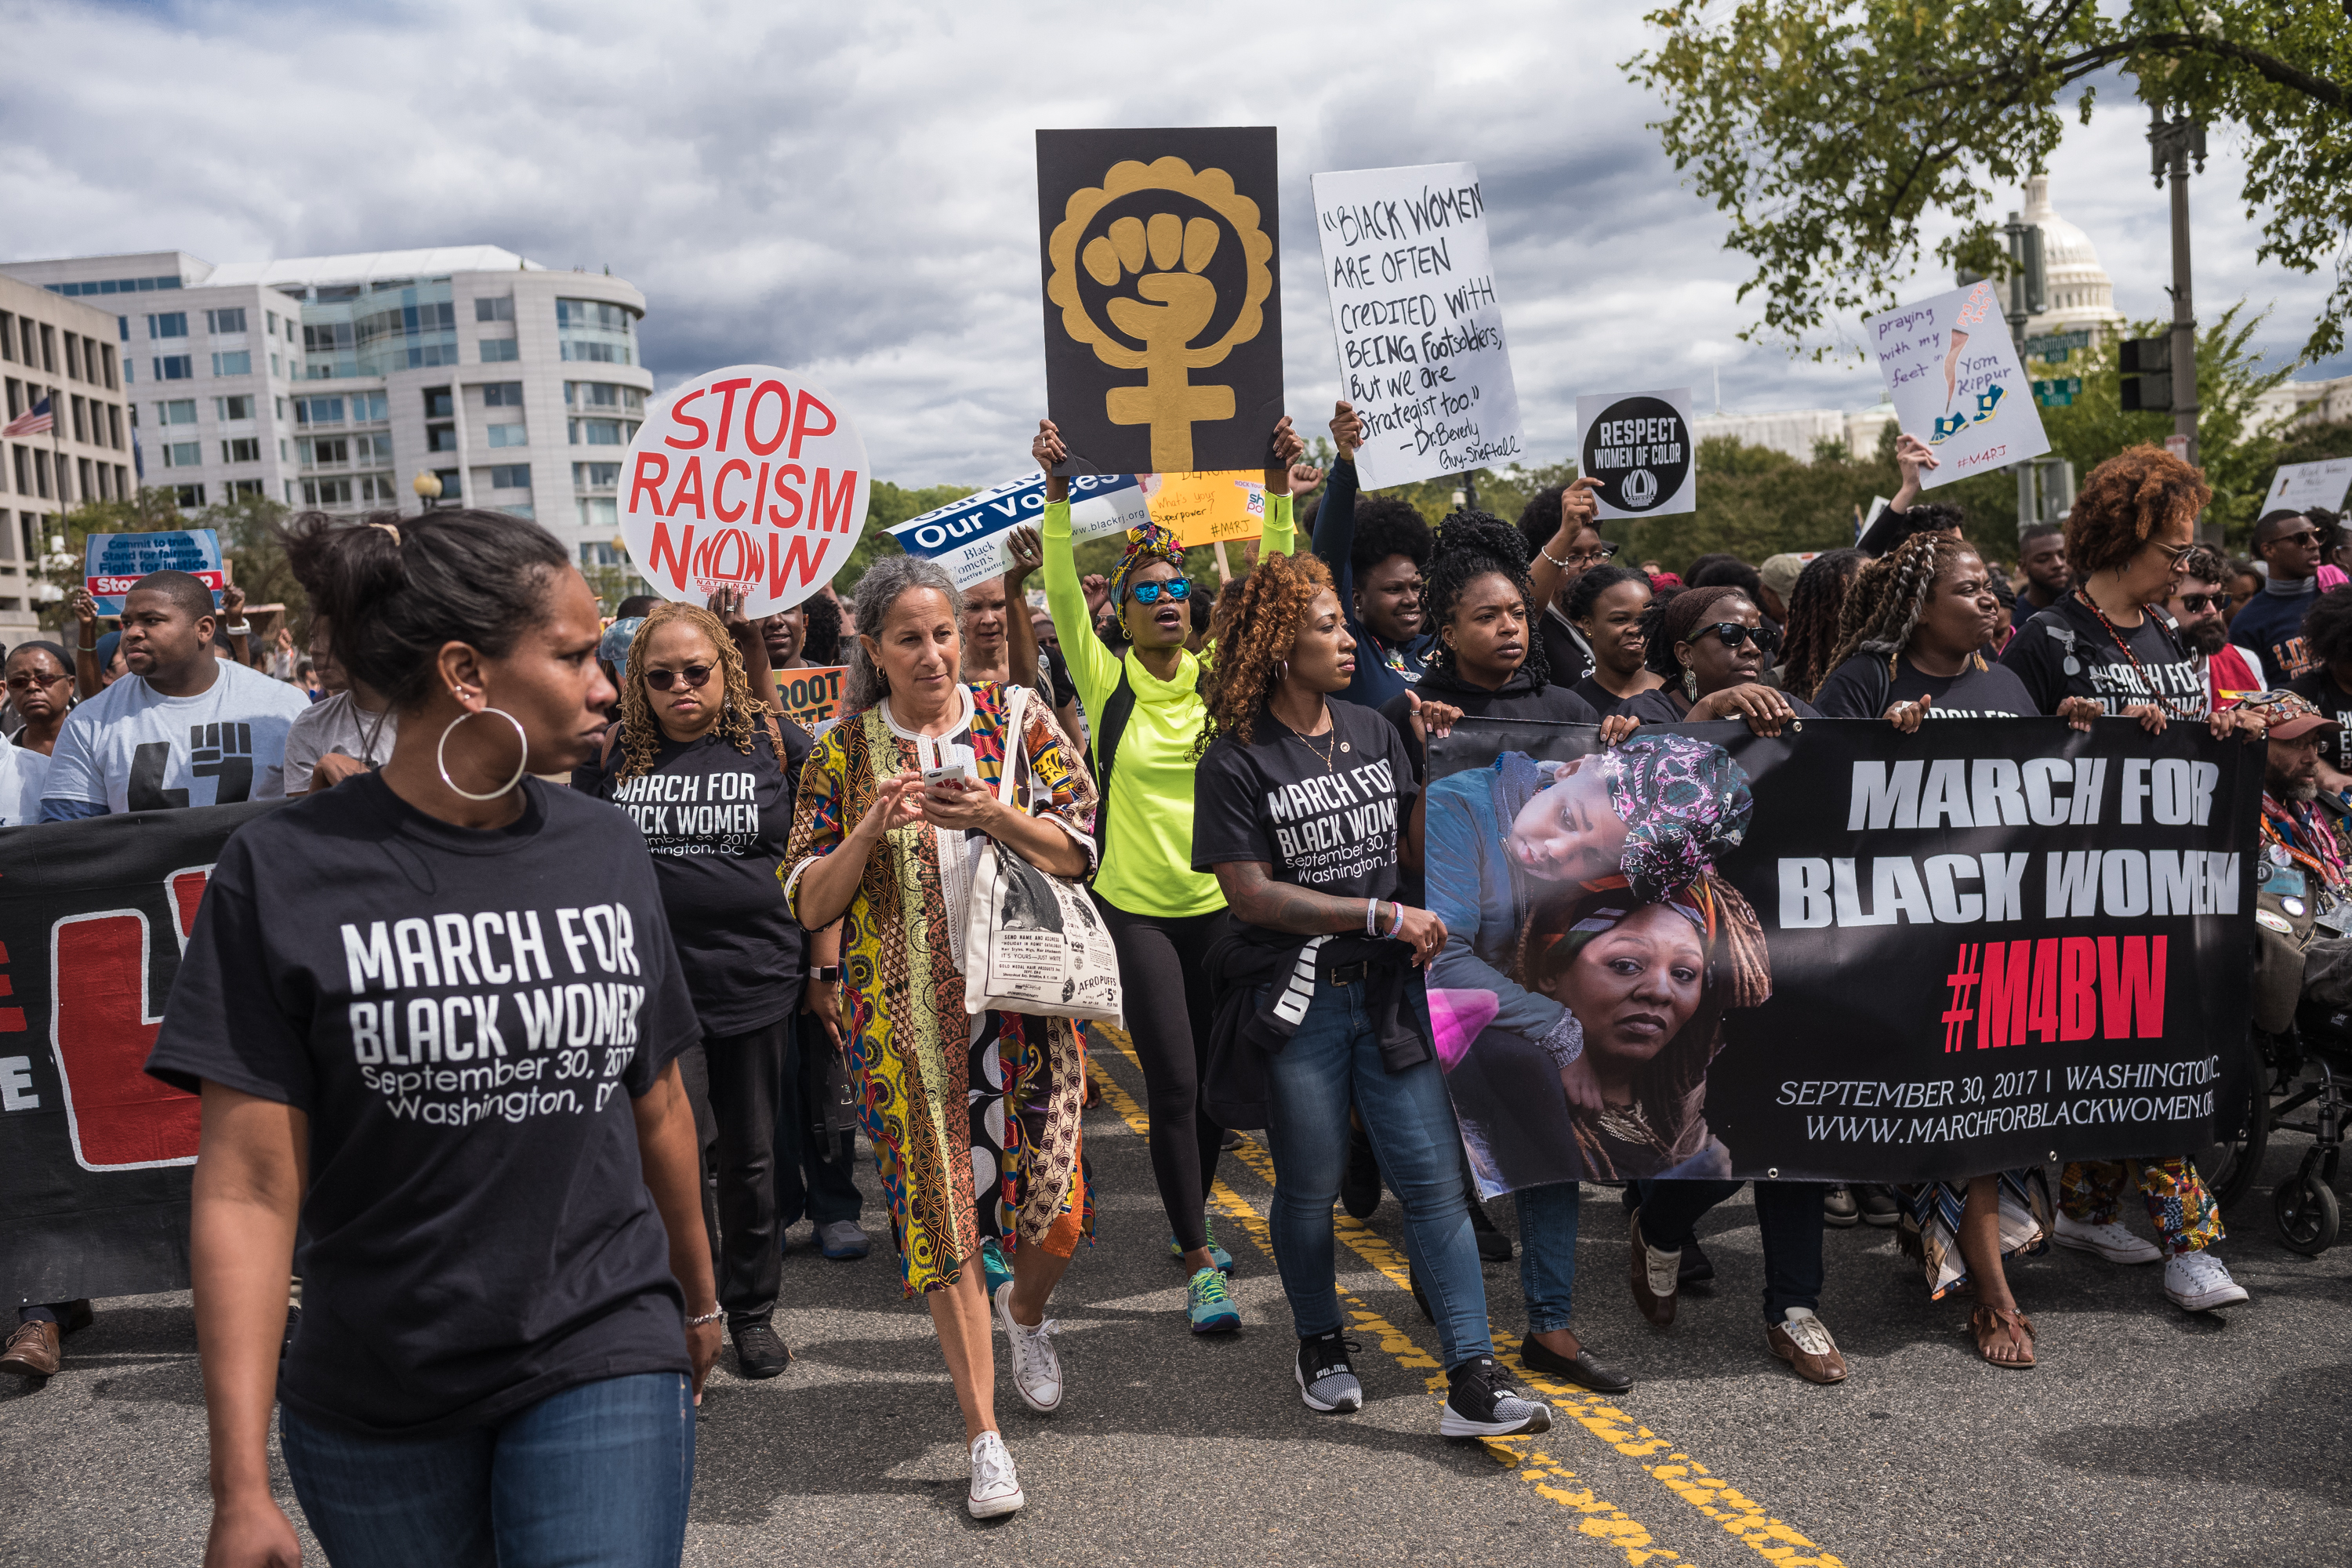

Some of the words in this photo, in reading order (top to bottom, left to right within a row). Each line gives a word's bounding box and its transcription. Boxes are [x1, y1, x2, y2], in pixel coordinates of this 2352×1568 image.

[1411, 182, 1485, 236] WOMEN
[1334, 255, 1375, 290] ARE
[1381, 237, 1451, 283] OFTEN
[1878, 308, 1934, 339] praying
[1345, 335, 1417, 369] BEING
[1879, 342, 1911, 363] with
[1918, 332, 1940, 348] my
[1892, 365, 1929, 389] feet
[1960, 355, 1998, 374] Yom
[1350, 373, 1381, 402] But
[1386, 369, 1416, 398] we
[1420, 365, 1456, 389] are
[1957, 368, 2011, 395] Kippur
[664, 377, 837, 459] STOP
[1359, 395, 1437, 441] Strategist
[1600, 417, 1677, 446] RESPECT
[1594, 447, 1633, 469] WOMEN
[1635, 445, 1649, 466] OF
[1651, 442, 1681, 465] COLOR
[1957, 444, 2007, 469] #M4RJ
[629, 452, 858, 533] RACISM
[991, 470, 1047, 495] Liv
[1156, 491, 1187, 509] What's
[1193, 491, 1215, 504] your
[915, 511, 984, 548] Our
[1071, 508, 1145, 537] ww.blackrj.org
[1210, 519, 1250, 538] #M4RJ
[102, 550, 136, 561] Stand
[140, 550, 157, 560] for
[159, 548, 203, 559] fairness
[108, 539, 151, 550] Commit
[154, 538, 165, 547] to
[168, 536, 194, 546] truth
[964, 541, 995, 561] Black
[99, 562, 136, 575] Fight
[140, 561, 160, 572] for
[163, 559, 209, 571] justice
[984, 560, 1006, 573] Justice
[696, 579, 755, 590] NATNAL
[612, 774, 700, 802] MARCH
[707, 772, 756, 801] FOR
[1268, 773, 1359, 824] MARCH
[1350, 758, 1396, 798] FOR
[1846, 757, 2107, 831] MARCH
[2121, 757, 2219, 826] FOR
[677, 804, 759, 835] WOMEN
[720, 844, 745, 855] DC
[722, 833, 759, 846] 2017
[1276, 816, 1346, 858] BLACK
[1286, 844, 1364, 872] September
[1298, 853, 1388, 884] Washington,
[1777, 851, 2030, 929] BLACK
[2045, 849, 2240, 918] WOMEN
[340, 910, 554, 994] MARCH
[556, 902, 641, 977] FOR
[1940, 935, 2169, 1054] #M4BW
[349, 994, 508, 1065] BLACK
[514, 982, 645, 1051] WOMEN
[361, 1056, 550, 1097] September
[555, 1048, 594, 1080] 30,
[1776, 1080, 1955, 1109] SEPTEMBER
[1960, 1076, 1987, 1105] 30,
[1992, 1070, 2038, 1100] 2017
[387, 1085, 584, 1126] Washington,
